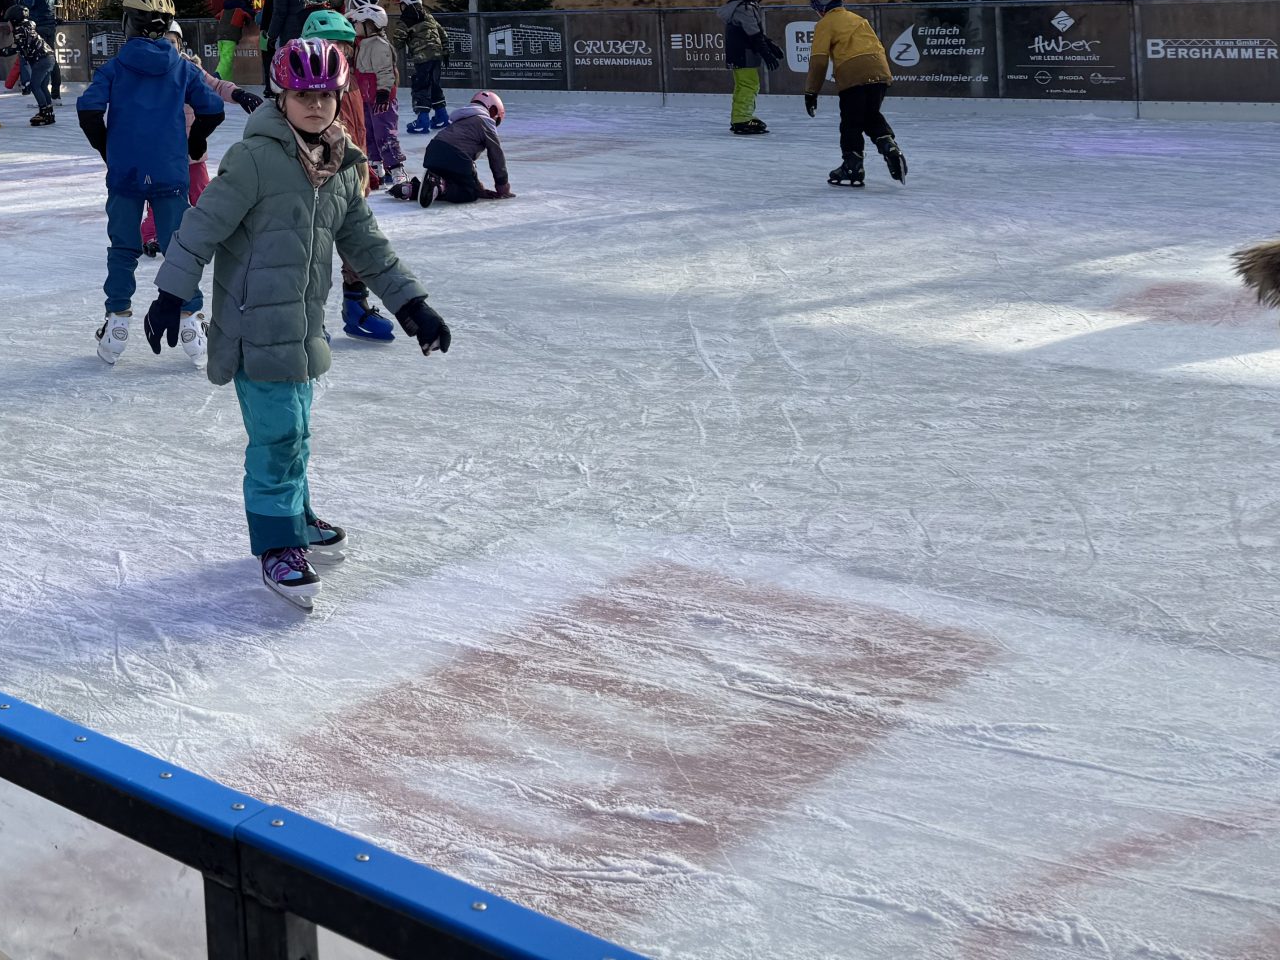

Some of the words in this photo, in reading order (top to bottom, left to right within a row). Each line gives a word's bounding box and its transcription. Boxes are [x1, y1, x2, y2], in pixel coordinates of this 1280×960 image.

[795, 30, 815, 44] RE
[917, 26, 960, 36] Einfach
[684, 33, 725, 49] BURG
[926, 36, 966, 45] tanken
[1027, 35, 1102, 54] Huber
[573, 39, 652, 56] GRUBER
[930, 46, 985, 56] waschen!
[1146, 39, 1279, 59] BERGHAMMER
[55, 48, 81, 63] EPP
[685, 49, 714, 61] büro
[1065, 53, 1101, 61] MOBILITÄT
[574, 58, 591, 66] DAS
[592, 57, 653, 66] GEWANDHAUS
[891, 73, 989, 83] www.zeislmeier.de
